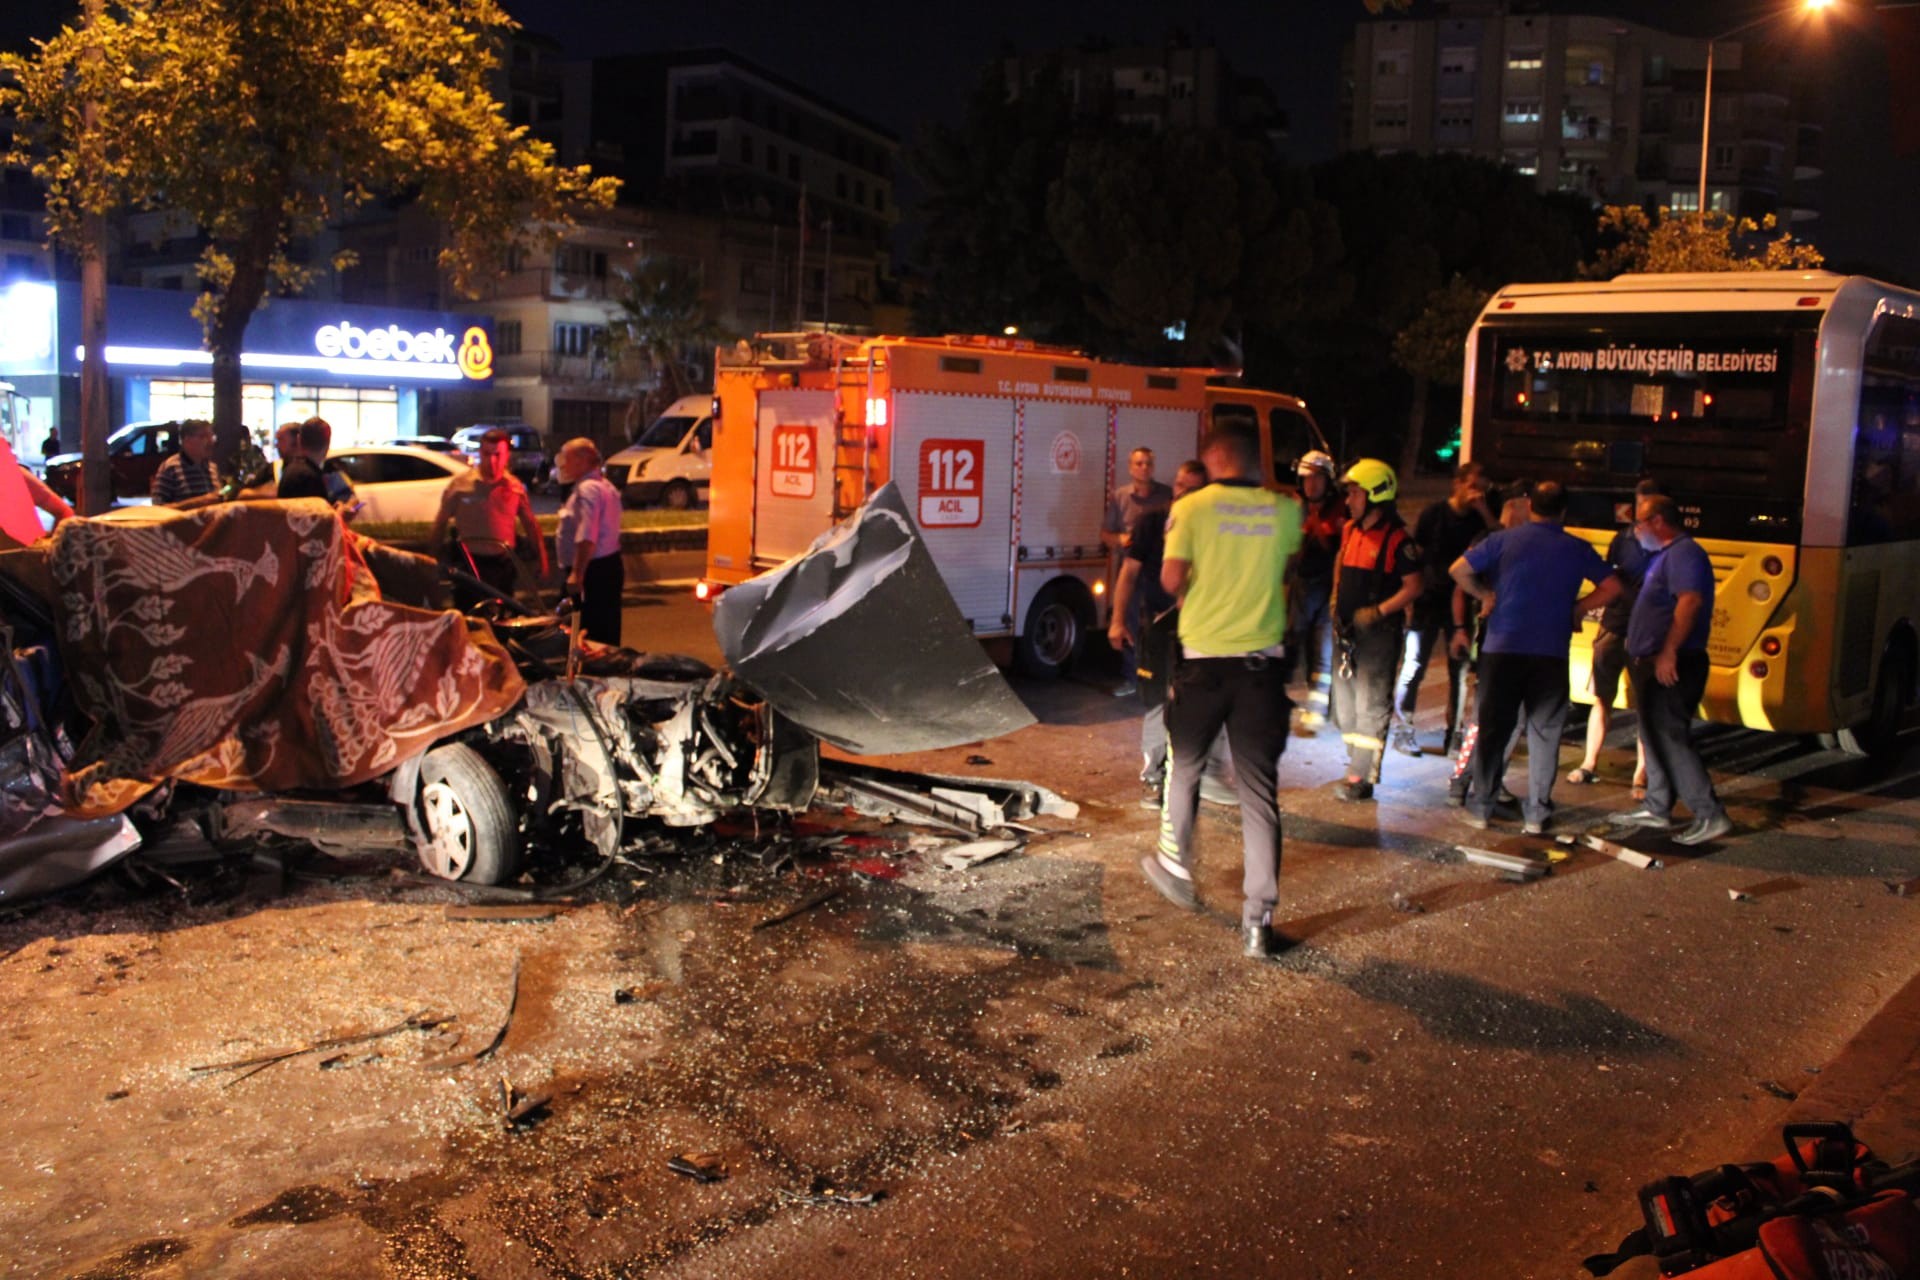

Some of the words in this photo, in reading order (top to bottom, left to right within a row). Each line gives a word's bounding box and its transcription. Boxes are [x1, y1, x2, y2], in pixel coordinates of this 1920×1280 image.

[315, 320, 456, 363] ebebek
[1556, 352, 1594, 370] AYDIN
[1596, 344, 1694, 377] BÜYÜKŞEHİR
[1697, 348, 1779, 372] BELEDİYESİ
[777, 432, 811, 468] 112
[928, 449, 975, 490] 112
